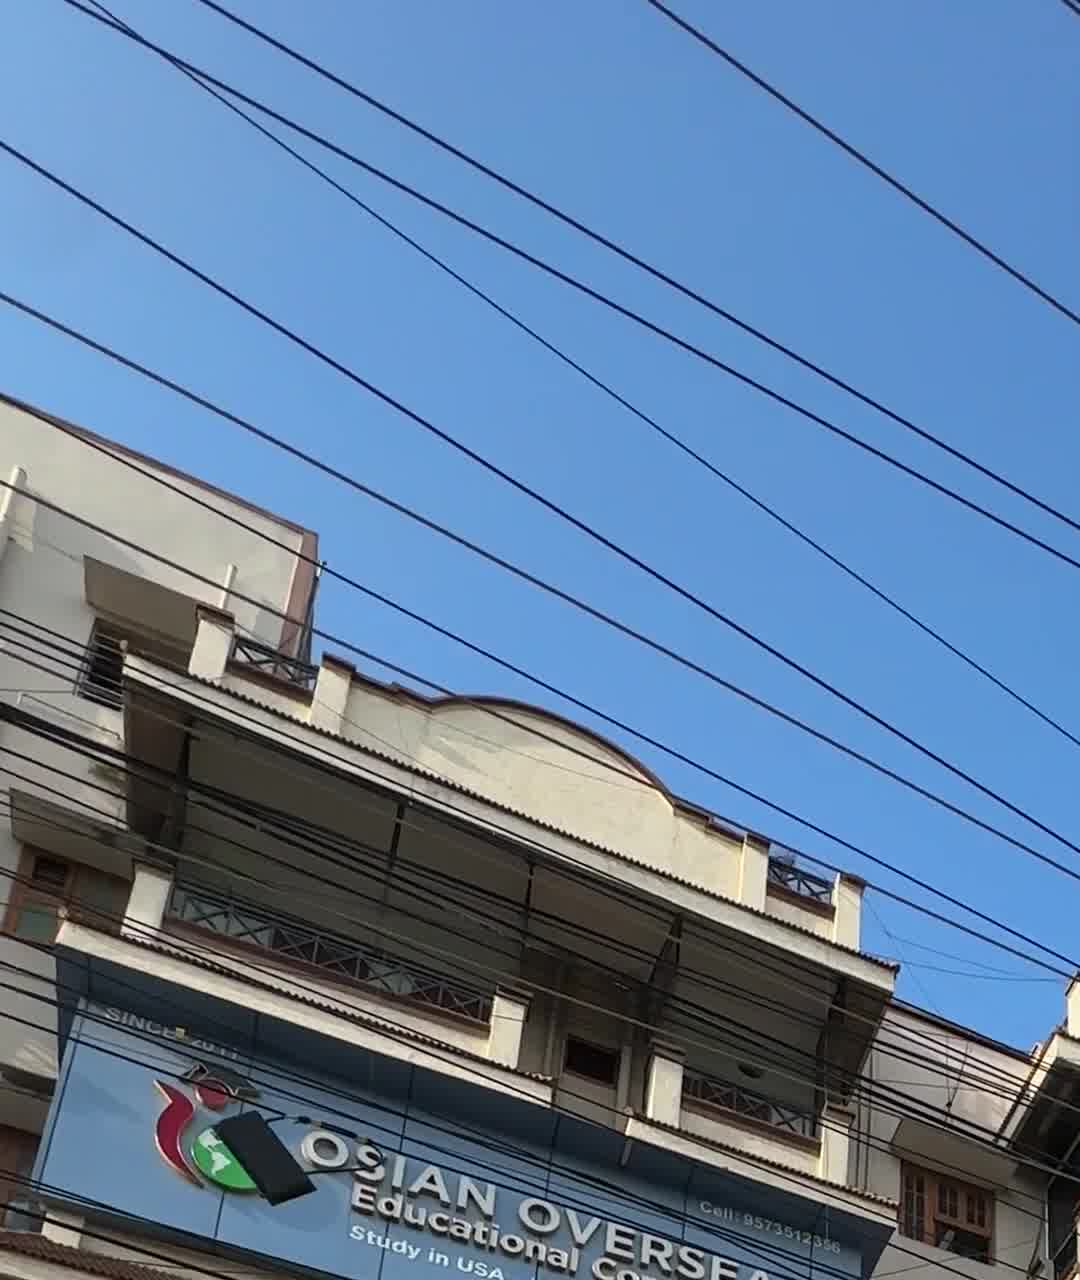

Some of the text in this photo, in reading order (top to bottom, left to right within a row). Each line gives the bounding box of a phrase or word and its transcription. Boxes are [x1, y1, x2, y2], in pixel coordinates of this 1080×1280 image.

[301, 1131, 499, 1218] OSIAN
[350, 1225, 421, 1260] Study
[428, 1248, 449, 1268] in
[351, 1182, 579, 1274] Educational
